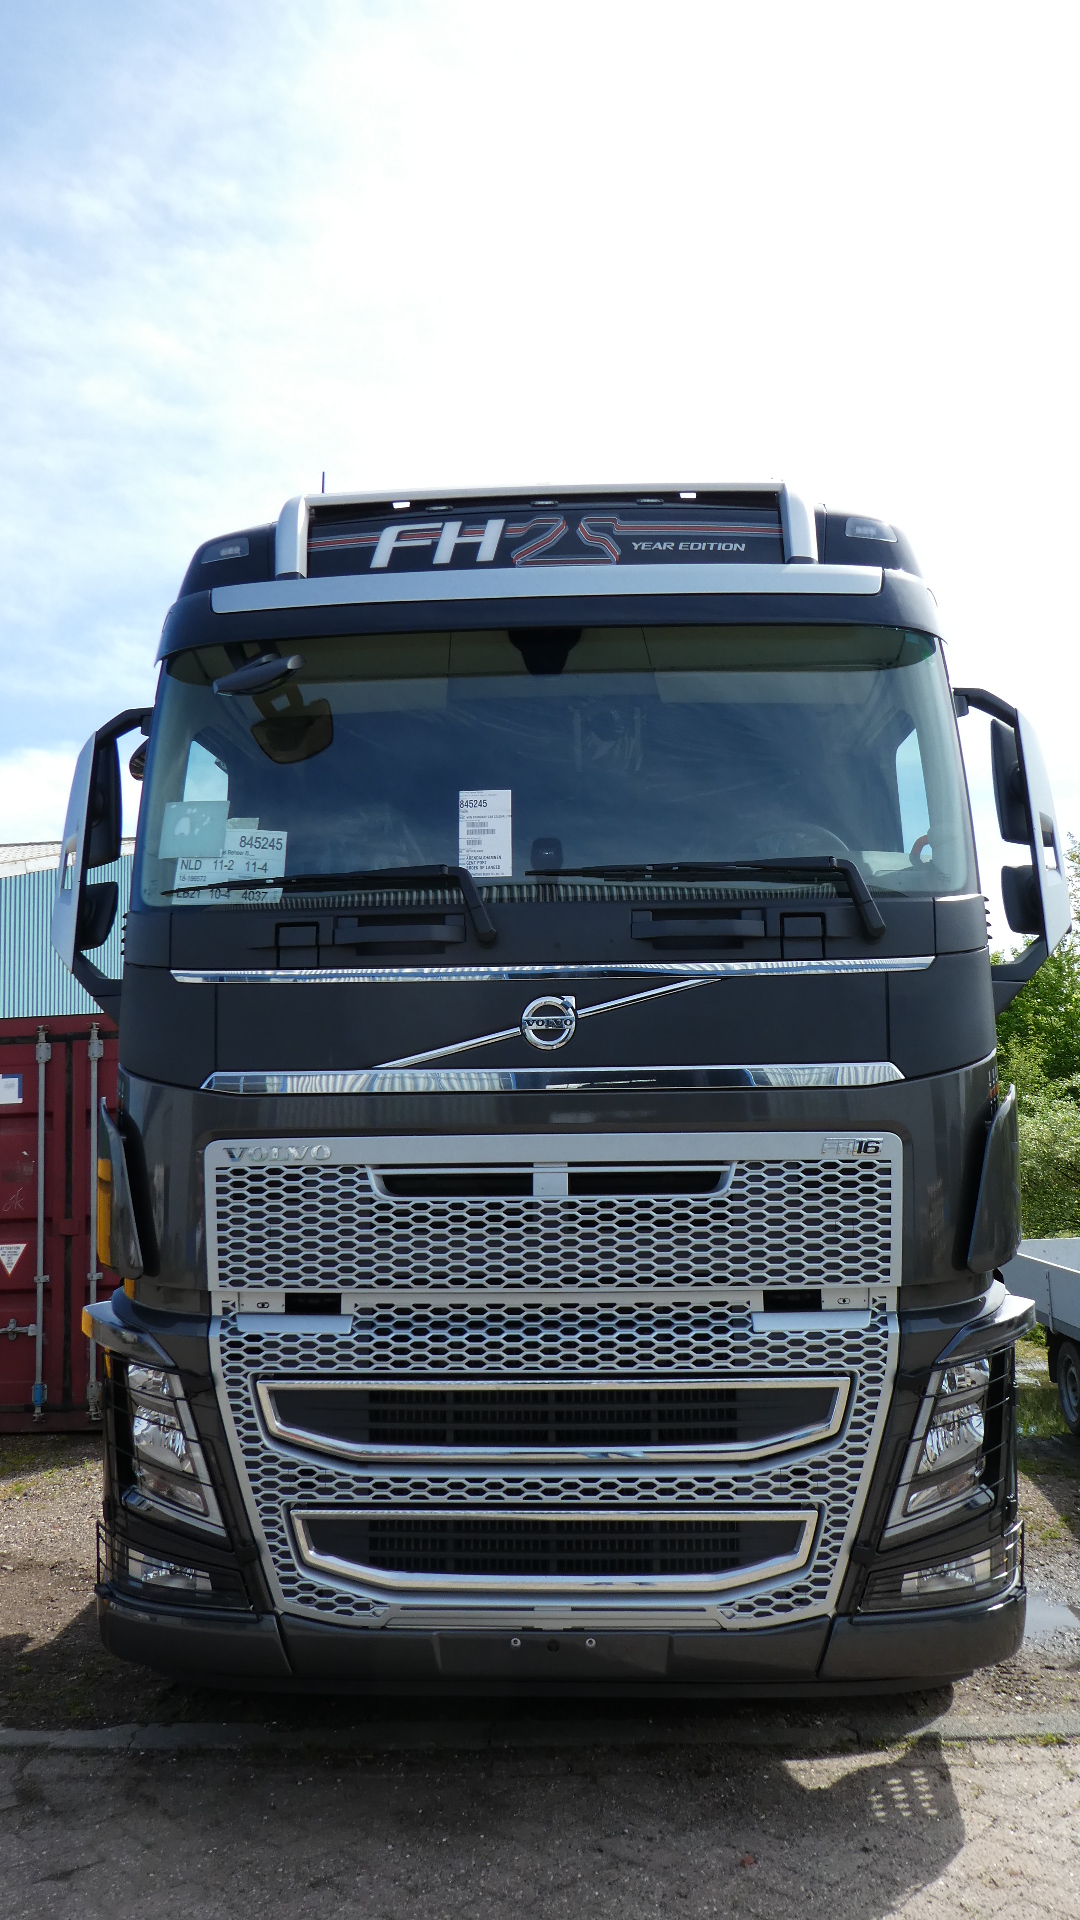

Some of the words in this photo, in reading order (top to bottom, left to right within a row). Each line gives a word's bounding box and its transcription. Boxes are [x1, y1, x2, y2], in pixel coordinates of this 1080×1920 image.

[632, 541, 675, 551] YEAR
[679, 542, 746, 552] EDITION
[459, 799, 488, 808] 845245
[239, 835, 283, 851] 845245
[180, 859, 202, 871] NLD
[213, 859, 235, 871] 11-2
[245, 860, 268, 874] 11-4
[241, 889, 268, 901] 4037
[525, 1019, 573, 1027] VOLVO
[223, 1145, 332, 1162] VOLVO
